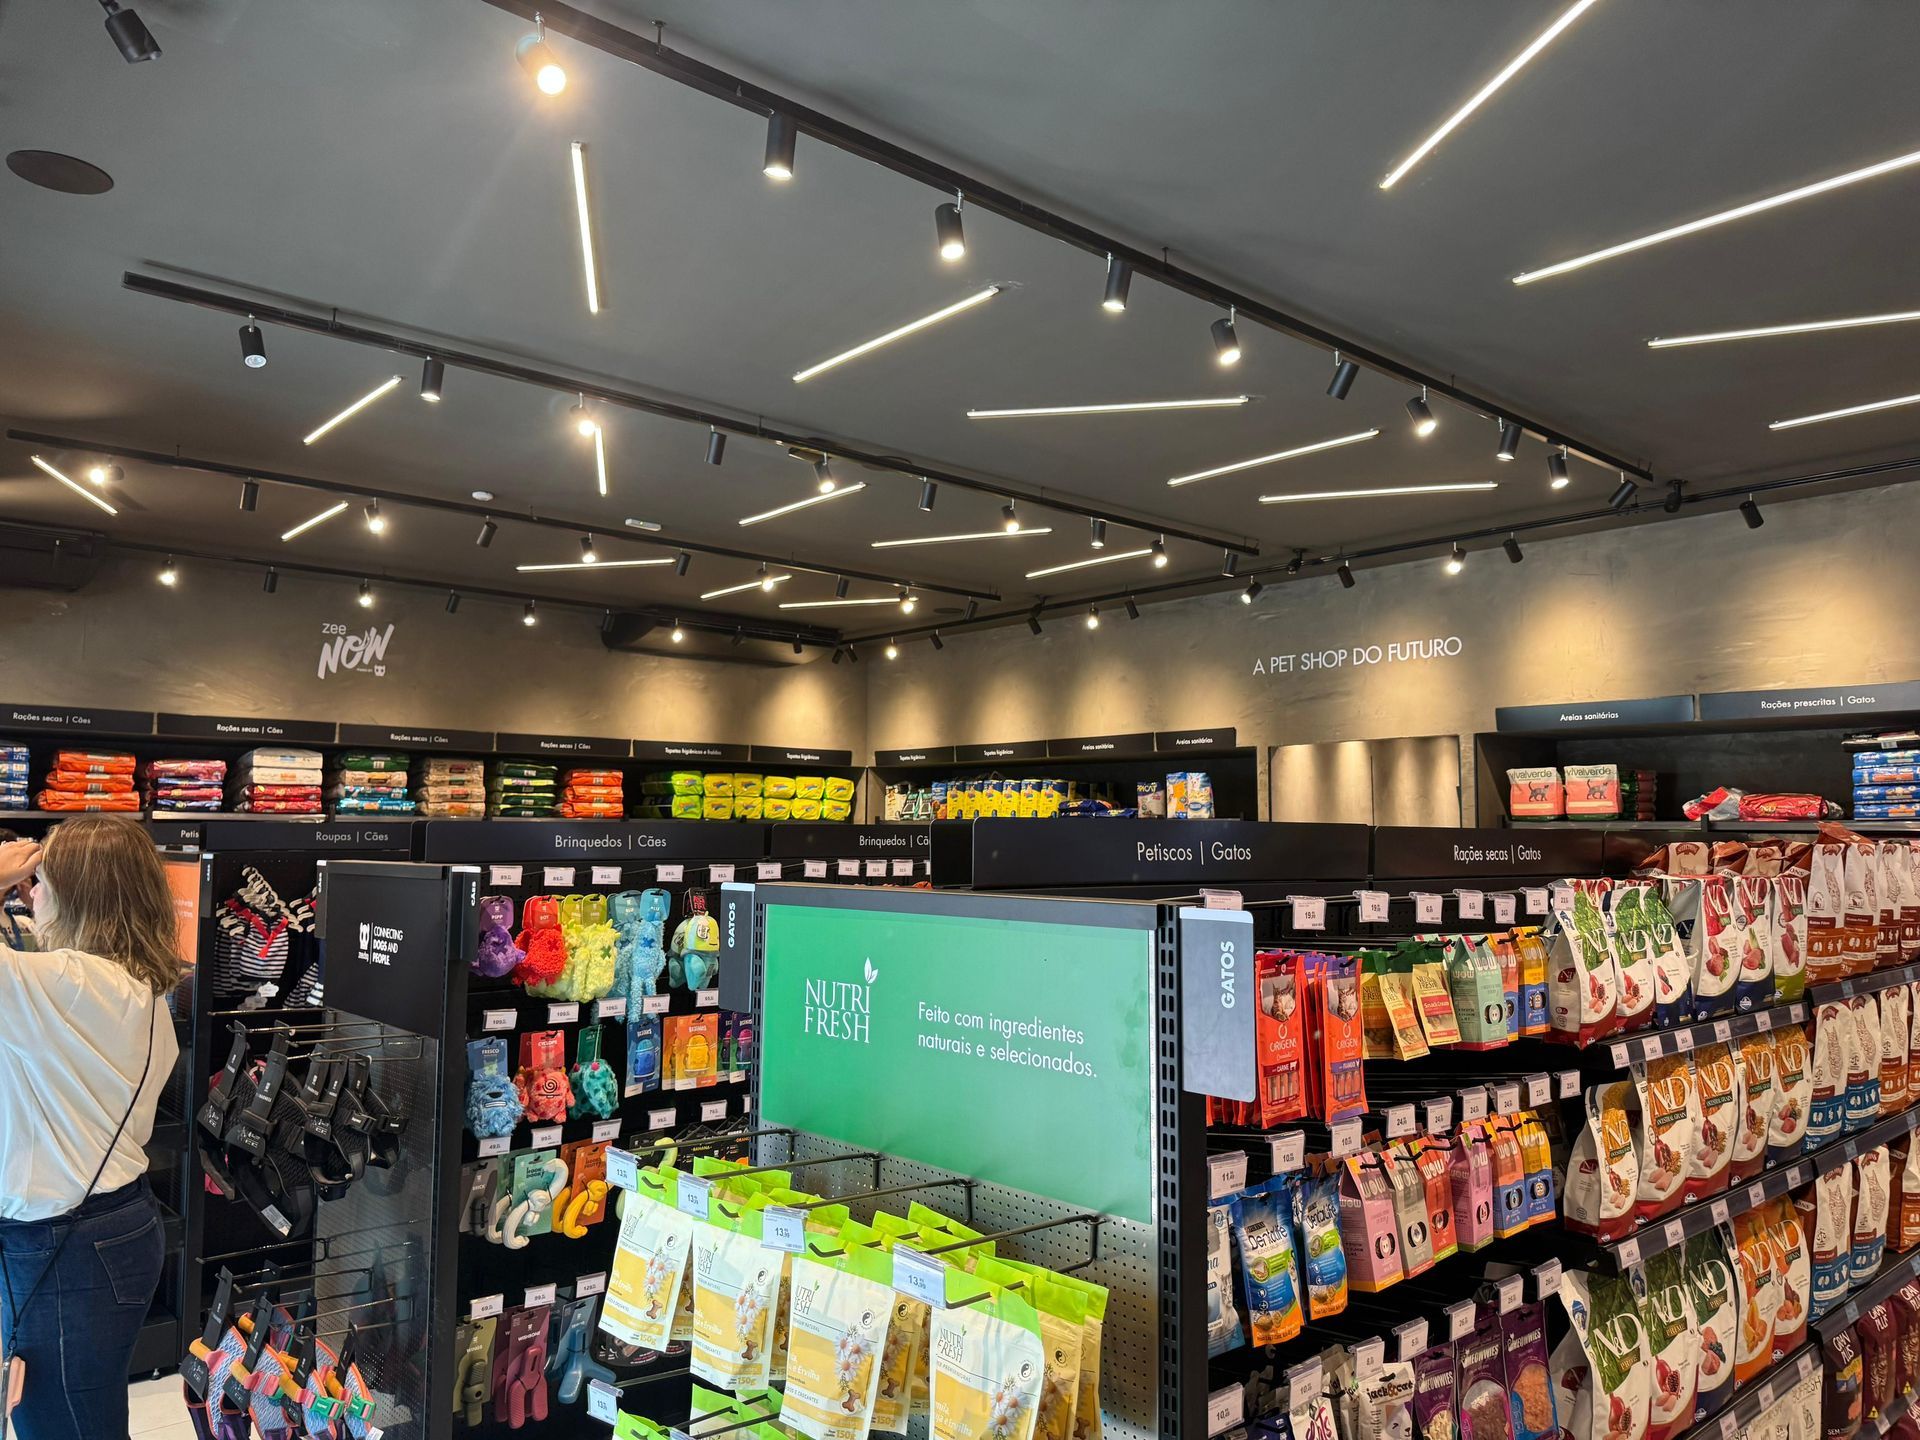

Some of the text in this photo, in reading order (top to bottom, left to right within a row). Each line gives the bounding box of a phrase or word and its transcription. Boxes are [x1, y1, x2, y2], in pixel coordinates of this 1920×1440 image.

[322, 622, 347, 635] zee
[317, 623, 395, 680] NOW
[1252, 636, 1463, 676] A PET SHOP DO FUTURO
[1761, 695, 1876, 710] Rações prescritas Gatos
[12, 712, 91, 724] Rações secas Cães
[1559, 711, 1619, 722] Areias sanitárias
[216, 723, 283, 734] Rações secas Cães
[390, 733, 411, 743] Rações
[412, 735, 428, 743] secas
[315, 831, 389, 842] Roupas Cães
[554, 834, 667, 852] Brinquedos Cães
[859, 834, 906, 849] Brinquedos
[1137, 841, 1252, 862] Petiscos Gatos
[1453, 844, 1542, 864] Rações secas Gatos
[373, 925, 404, 941] CONNECTING
[727, 902, 736, 948] GATOS
[373, 938, 399, 954] DOGS AND
[1220, 940, 1236, 1009] GATOS
[804, 977, 871, 1014] NUTRI
[804, 1005, 871, 1044] FRESH
[918, 1001, 1084, 1046] Feito com ingredientes
[918, 1031, 1098, 1078] naturais e selecionados.
[1592, 1312, 1642, 1368] N&D
[1366, 1379, 1414, 1403] jack&cat
